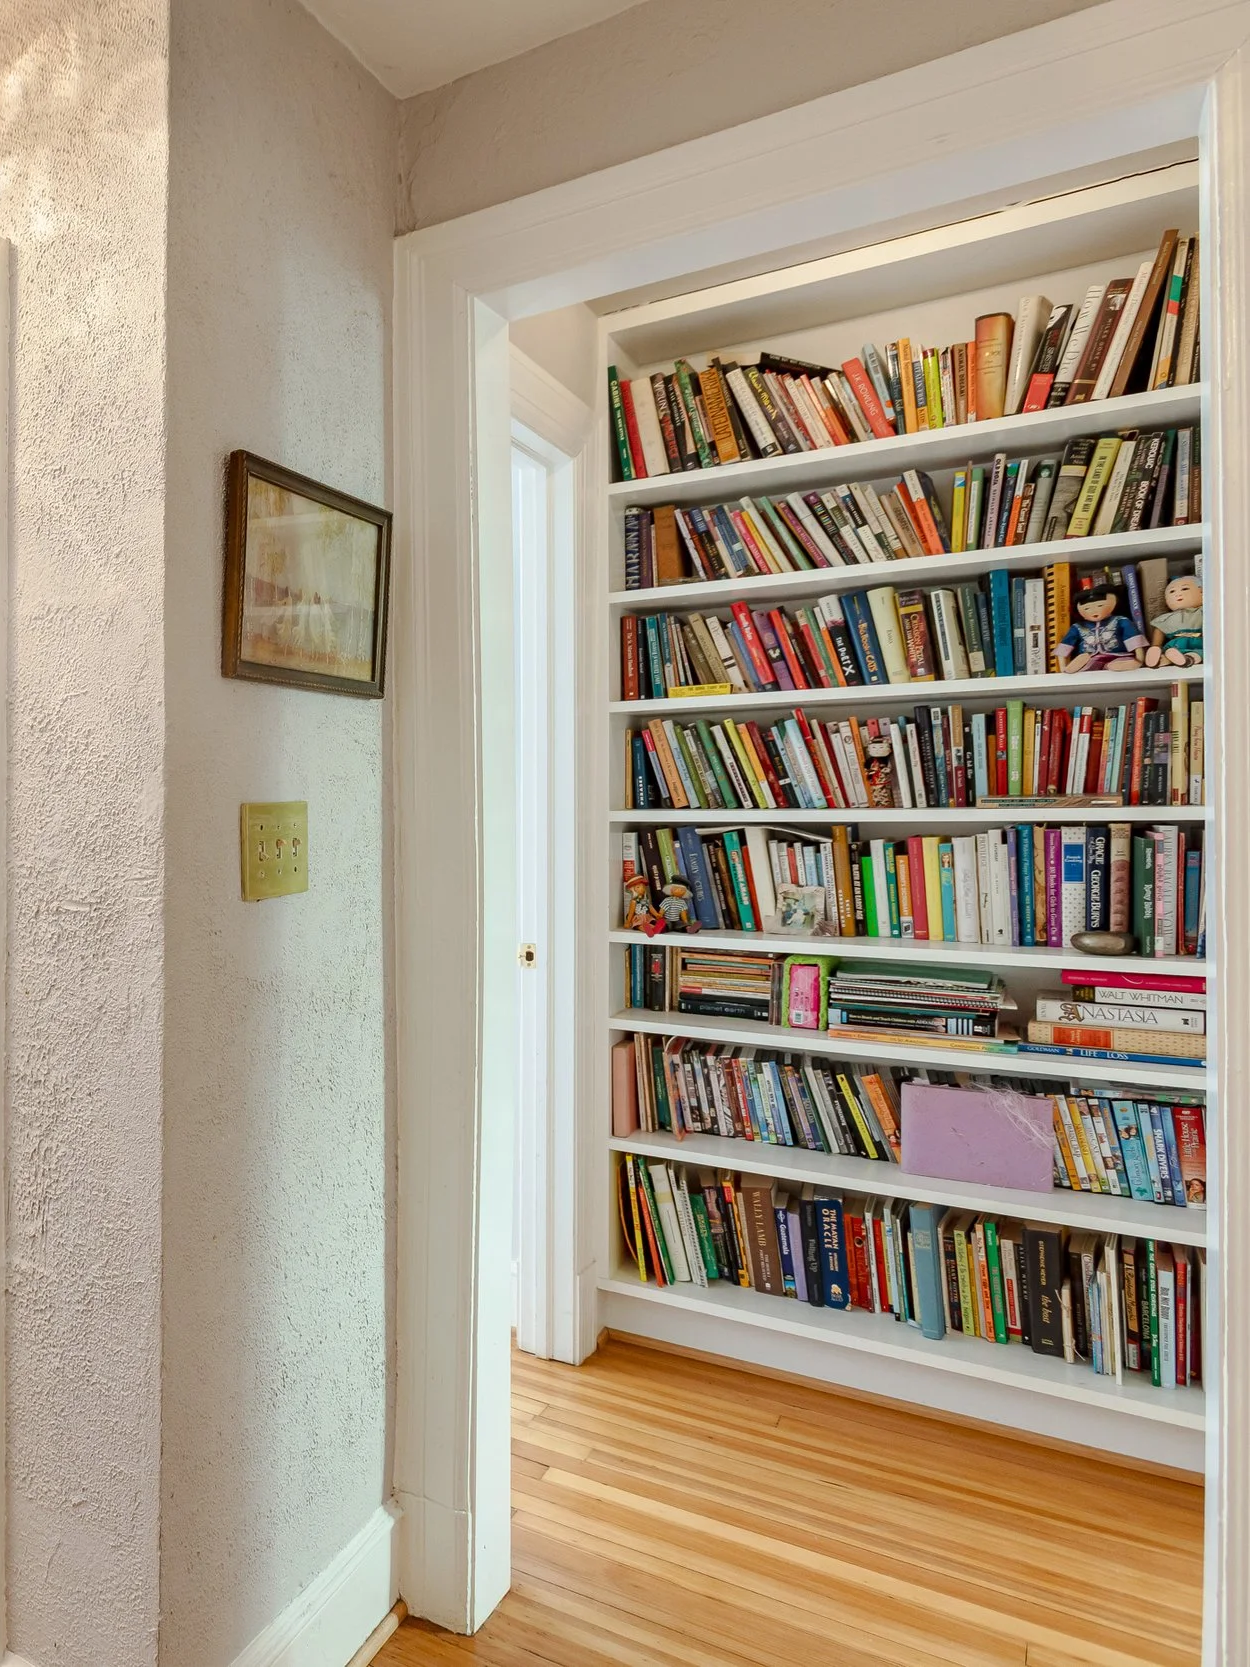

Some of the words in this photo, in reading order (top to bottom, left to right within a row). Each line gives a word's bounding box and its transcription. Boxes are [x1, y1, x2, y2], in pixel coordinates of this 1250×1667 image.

[1072, 325, 1090, 347] We
[1061, 350, 1080, 375] Die
[610, 380, 620, 408] CABINS
[858, 384, 878, 416] ROWLING
[1145, 438, 1160, 469] KEROUAC
[1094, 469, 1104, 479] LAND
[1136, 481, 1149, 499] BOOK
[1135, 500, 1144, 509] OF
[910, 614, 921, 645] CRIMSON
[907, 639, 916, 662] WHITE
[915, 646, 924, 665] PETAL
[843, 665, 855, 676] X
[865, 655, 877, 672] CATS
[1095, 837, 1106, 865] GRACIE
[1091, 870, 1101, 901] GEORGE
[1091, 902, 1101, 928] BURNS
[1098, 990, 1126, 999] WALT
[1129, 992, 1183, 1004] WHITMAN
[1058, 1003, 1158, 1024] ANASTASIA
[1107, 1051, 1129, 1060] LOSS
[1153, 1129, 1166, 1154] SHARK
[1157, 1154, 1168, 1179] DIVERS
[752, 1191, 762, 1219] WALLY
[755, 1222, 766, 1246] LAMB
[779, 1224, 790, 1255] Guatemala
[822, 1208, 830, 1249] ORACLE
[831, 1223, 839, 1249] MAYAN
[1041, 1295, 1051, 1308] the
[1042, 1308, 1052, 1324] host
[1141, 1300, 1150, 1339] BARCELONA
